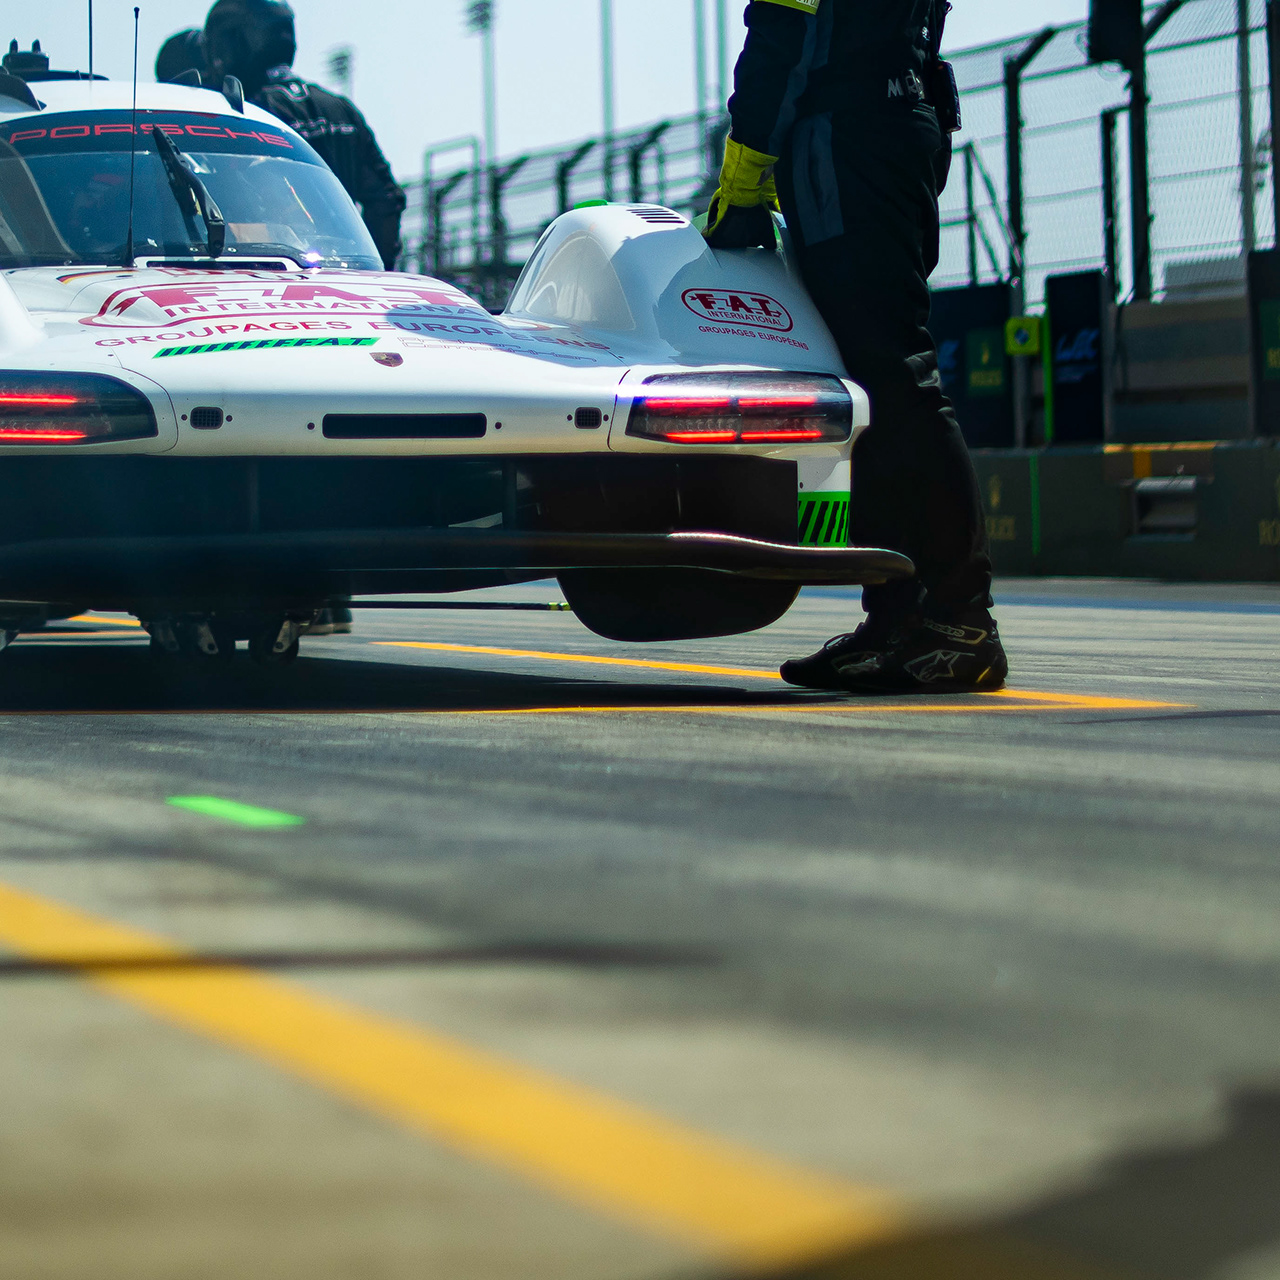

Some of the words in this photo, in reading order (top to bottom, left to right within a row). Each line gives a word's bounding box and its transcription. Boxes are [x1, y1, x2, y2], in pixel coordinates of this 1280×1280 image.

[9, 123, 294, 148] PORSCHE
[164, 300, 486, 318] INTERNATIONA
[707, 310, 785, 327] INTERNATIONAL
[95, 321, 353, 347] GROUPAGES
[698, 325, 756, 338] GROUPAGES
